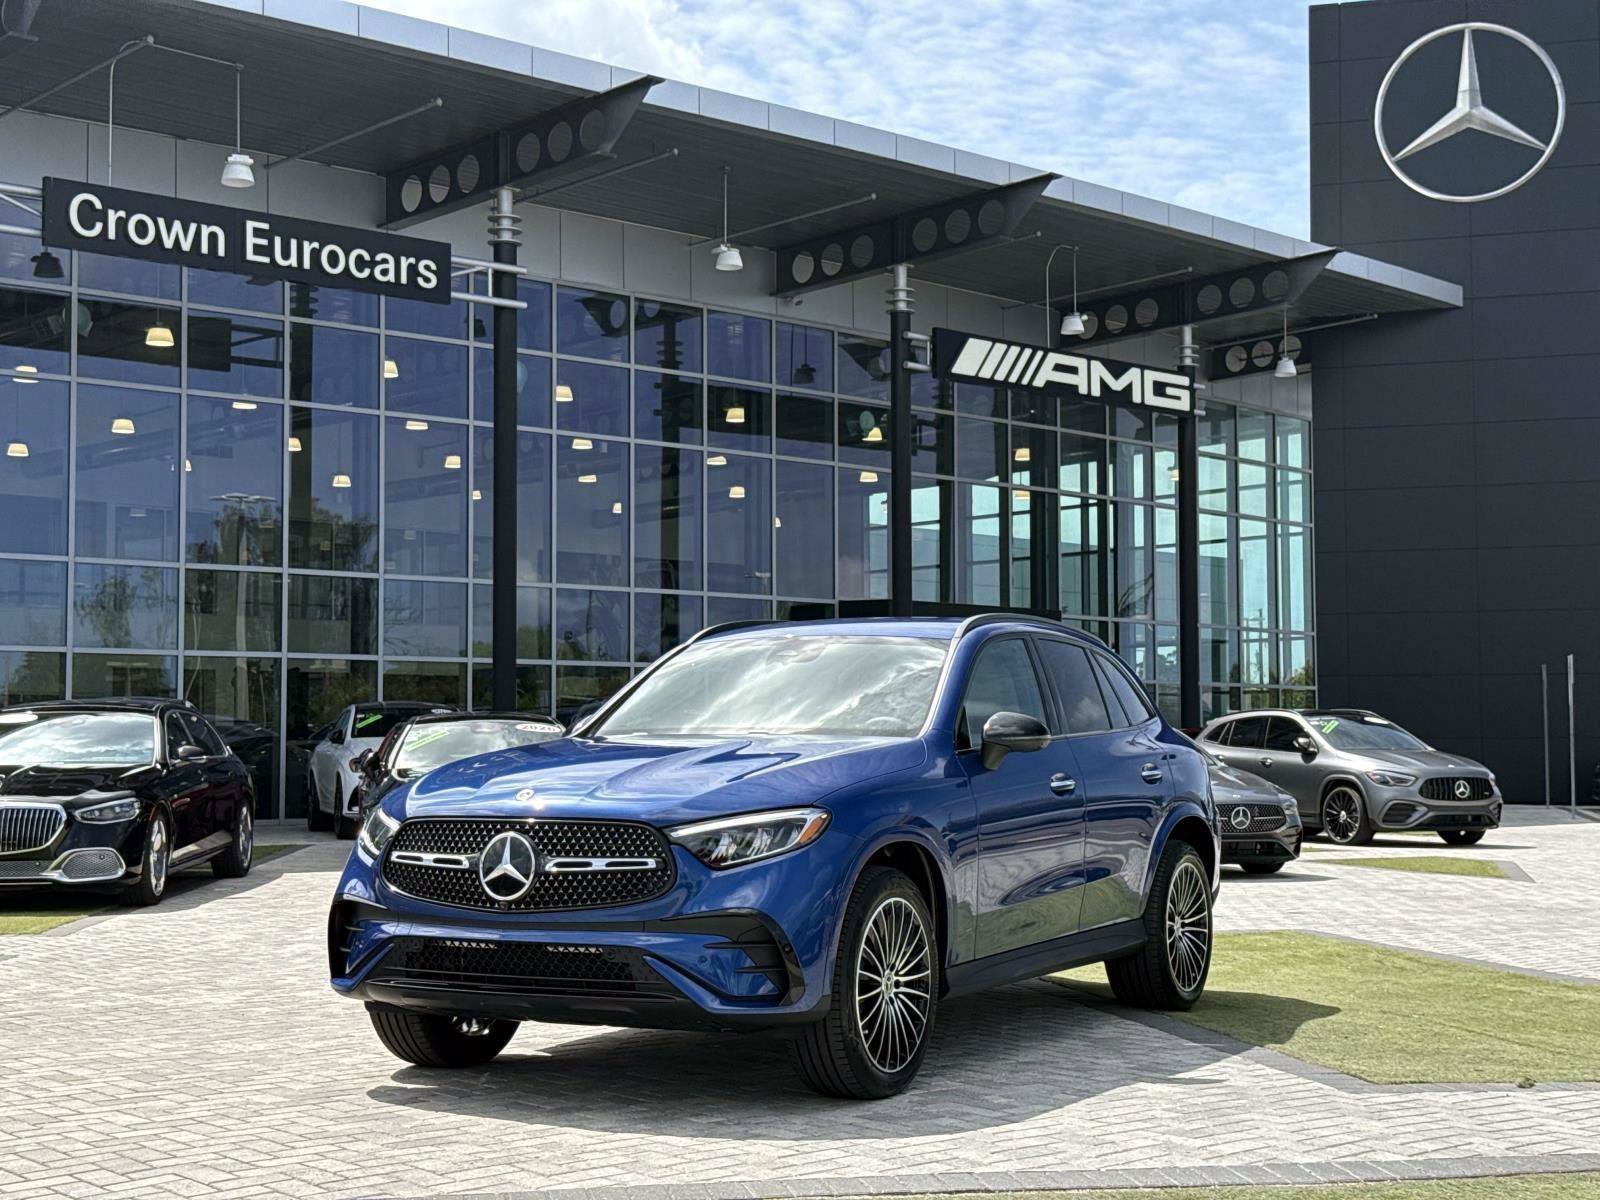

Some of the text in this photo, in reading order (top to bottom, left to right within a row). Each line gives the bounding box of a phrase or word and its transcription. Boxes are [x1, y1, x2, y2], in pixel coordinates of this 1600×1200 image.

[68, 192, 439, 289] Crown Eurocars
[1032, 351, 1191, 412] AMG
